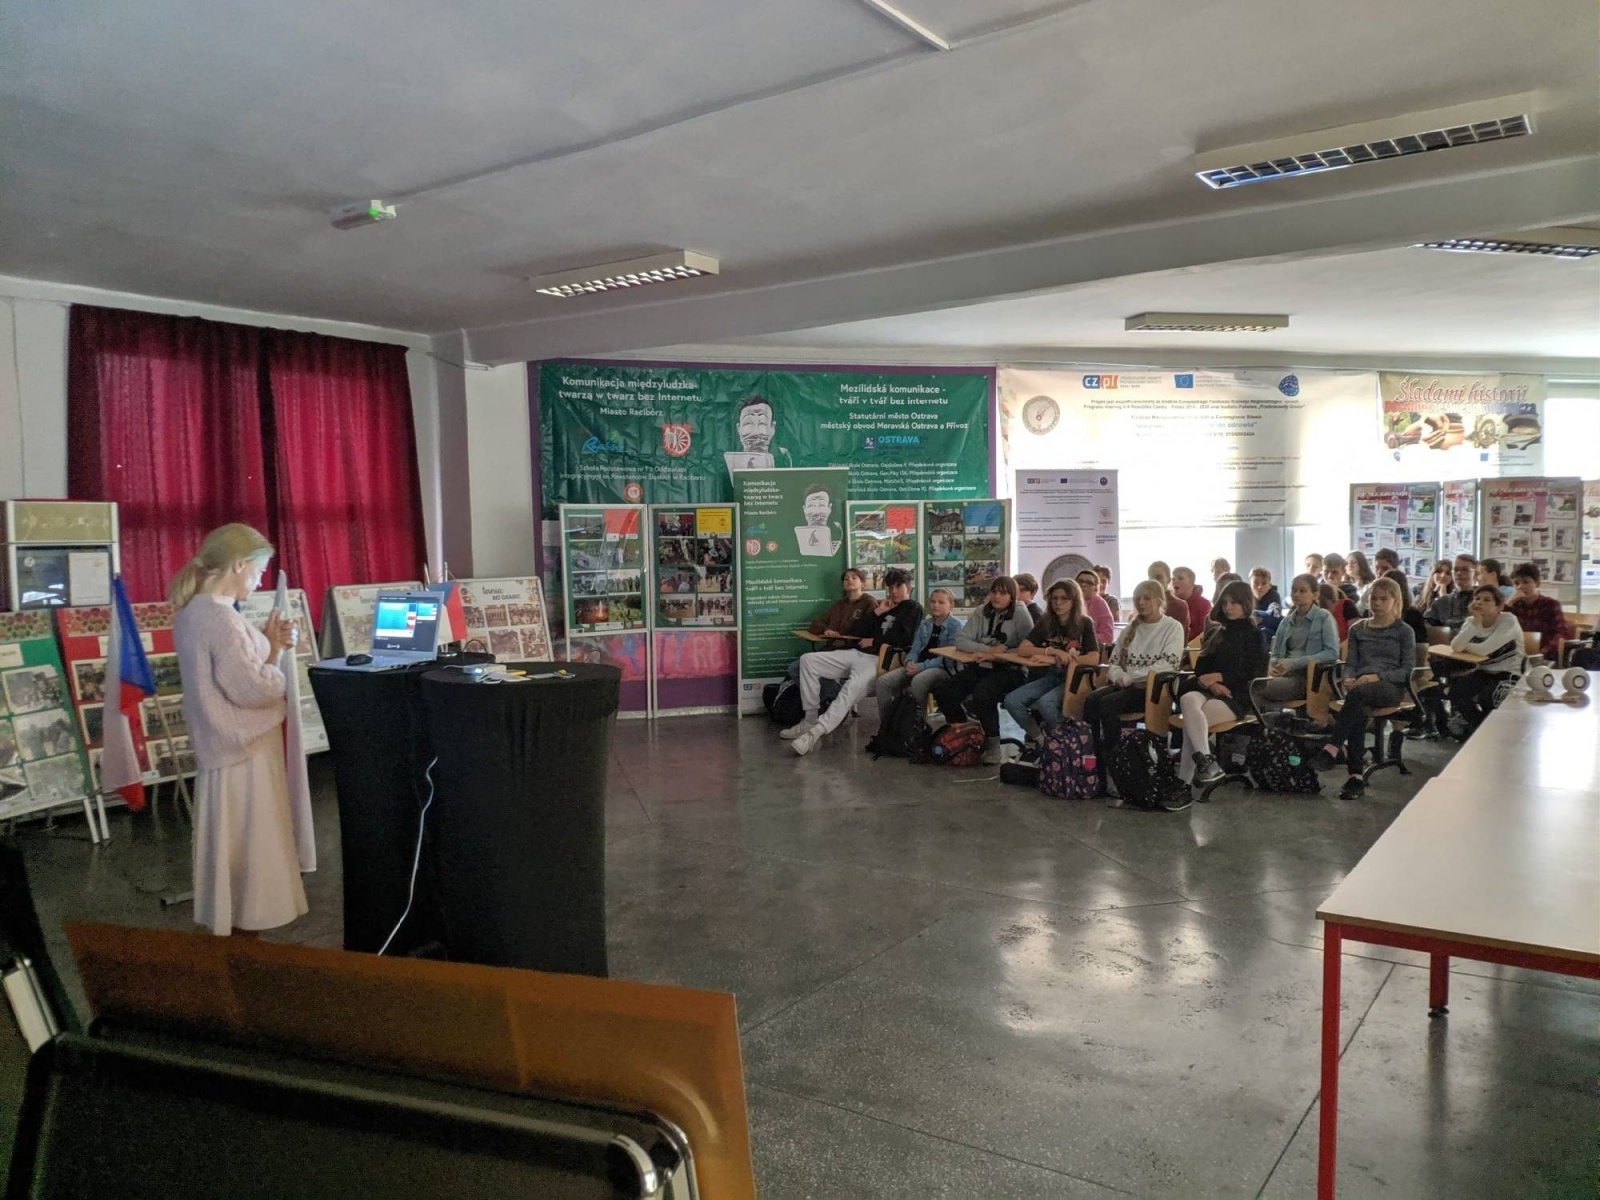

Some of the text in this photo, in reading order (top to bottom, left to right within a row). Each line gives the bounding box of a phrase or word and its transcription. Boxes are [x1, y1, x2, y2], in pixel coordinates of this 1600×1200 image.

[562, 376, 625, 390] Komunikacja
[840, 383, 887, 394] Mezilidská
[889, 383, 940, 394] komunikace
[1396, 375, 1528, 404] Śladami historii
[559, 389, 593, 402] twarzą
[606, 391, 635, 401] twarz
[637, 391, 655, 401] bez
[658, 392, 703, 402] Internetu
[839, 396, 860, 405] tváří
[870, 396, 888, 405] tvář
[890, 396, 905, 405] bez
[907, 396, 949, 405] internetu
[599, 407, 664, 418] Miasto Racibórz
[849, 412, 938, 420] Statutární město Ostrava
[820, 421, 851, 431] městský
[853, 421, 875, 430] obvod
[877, 421, 910, 430] Moravská
[911, 422, 939, 430] Ostrava
[946, 421, 969, 430] Přívoz
